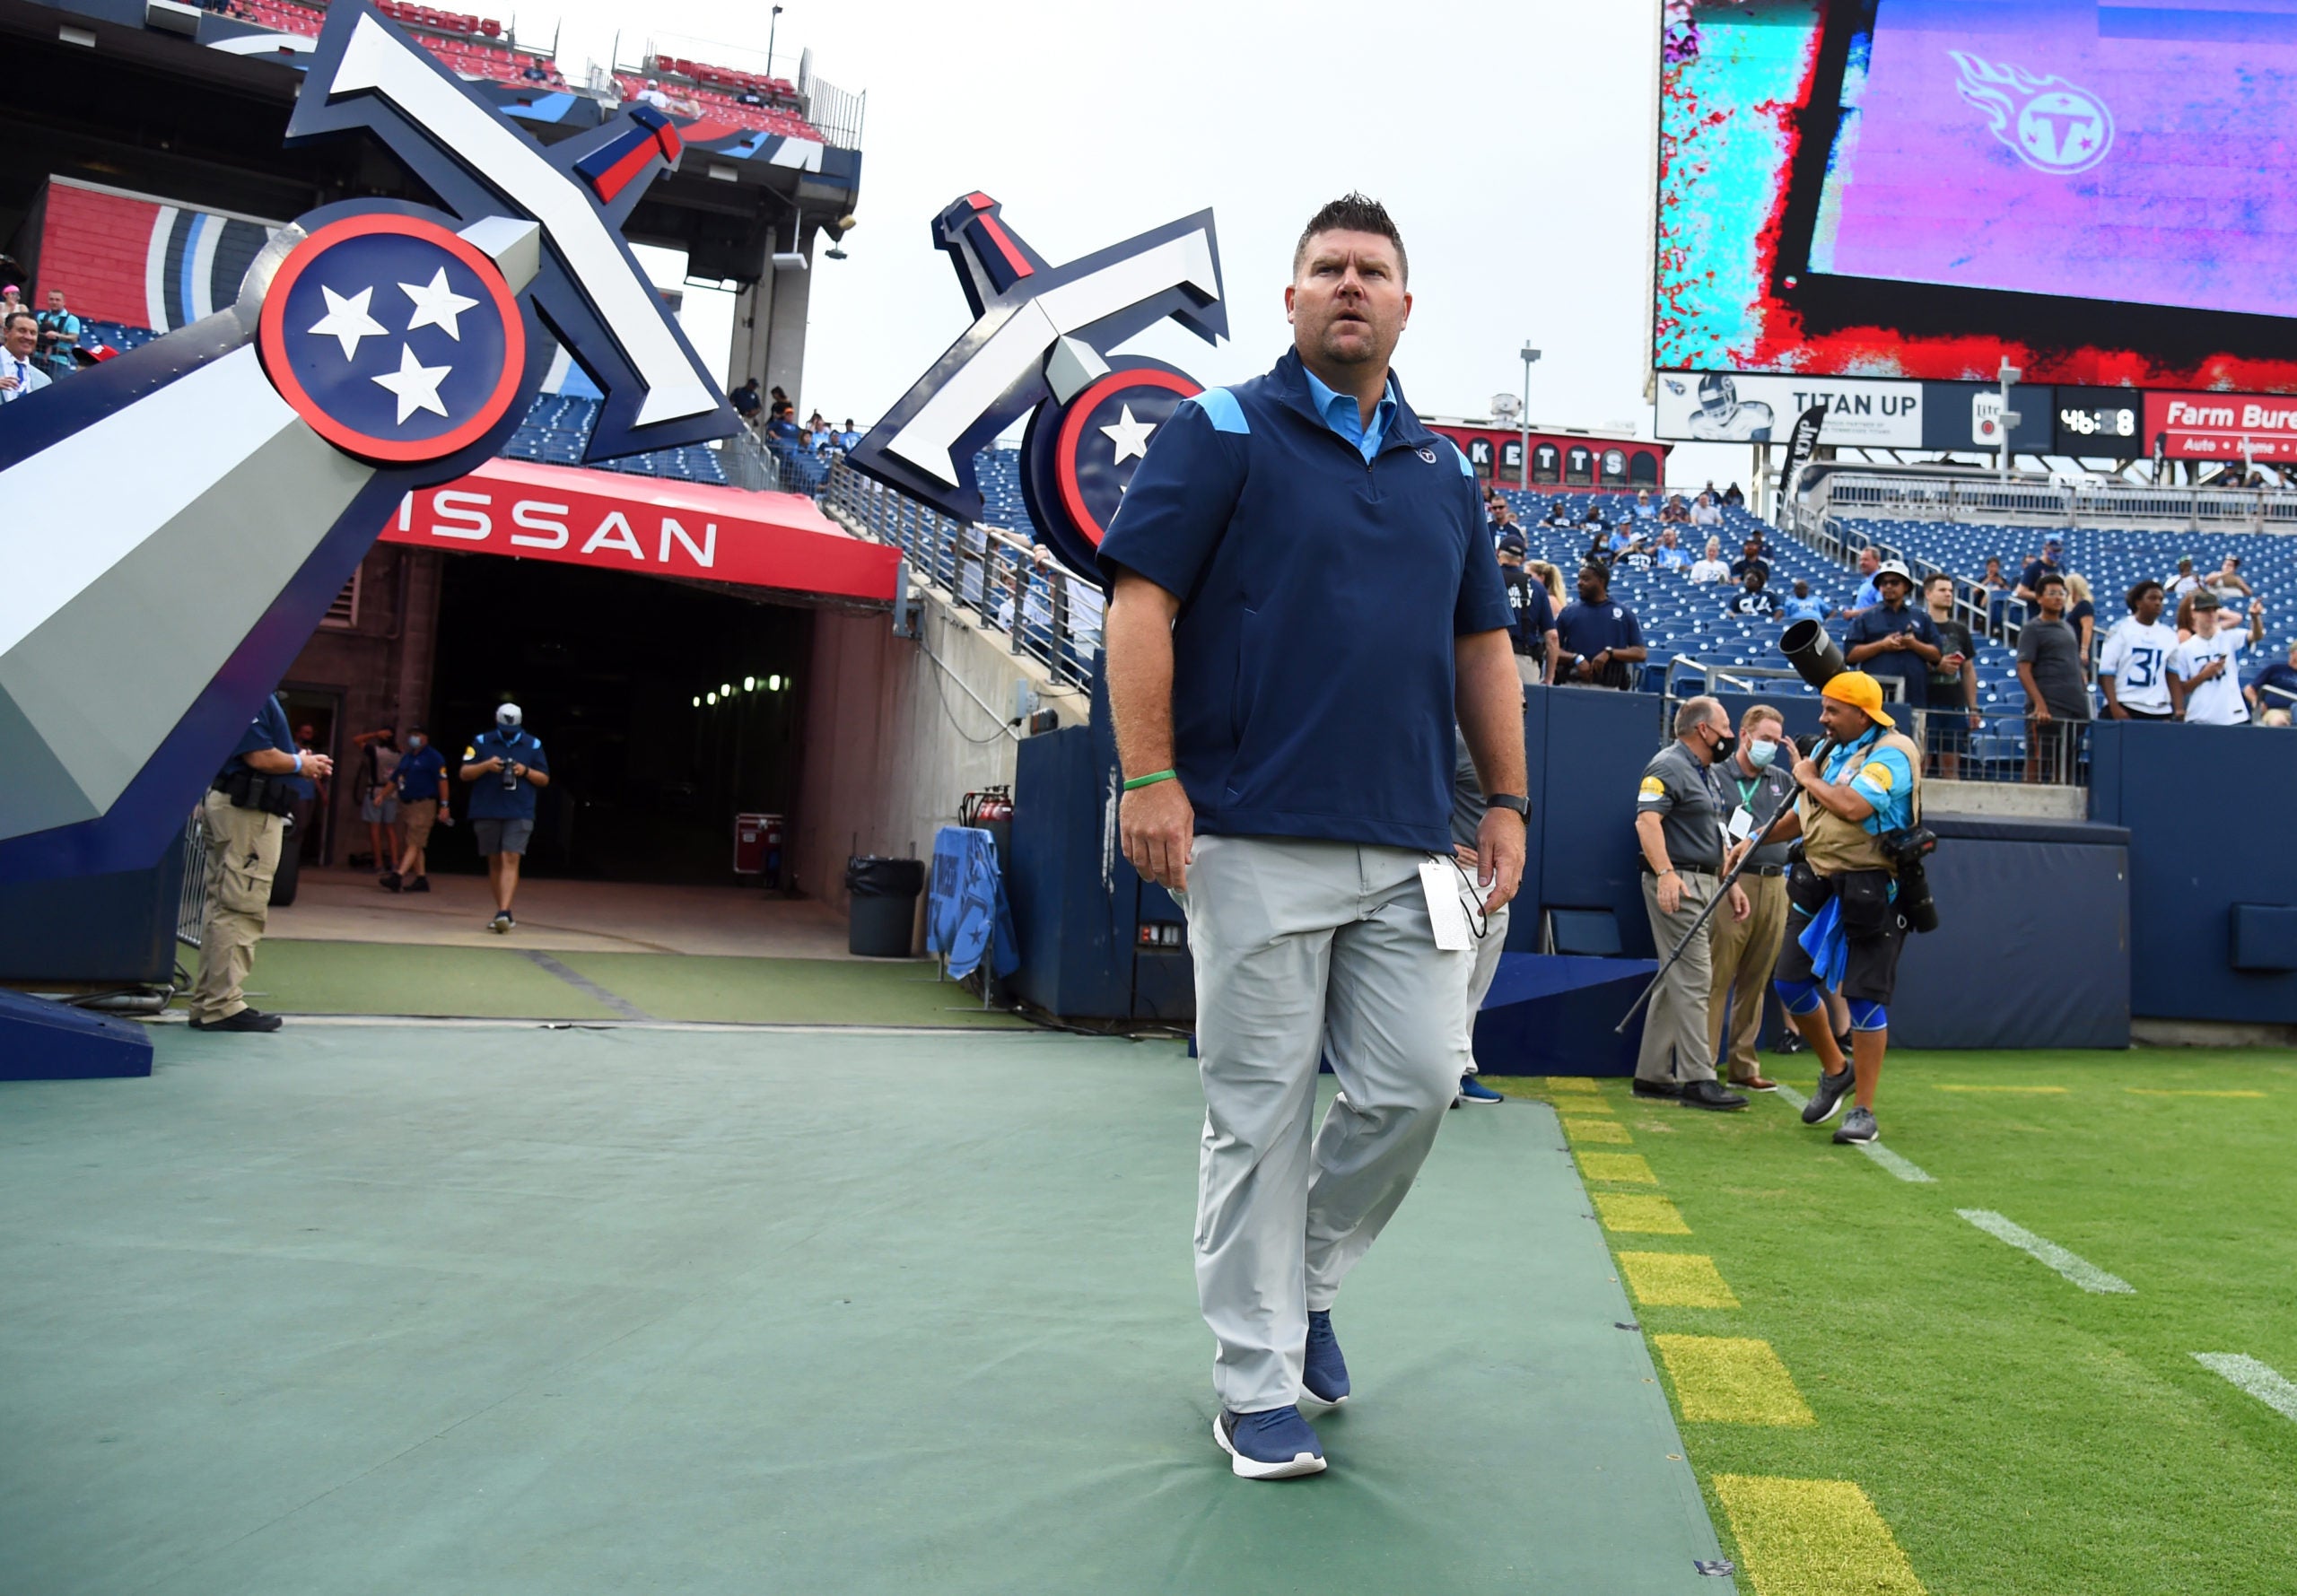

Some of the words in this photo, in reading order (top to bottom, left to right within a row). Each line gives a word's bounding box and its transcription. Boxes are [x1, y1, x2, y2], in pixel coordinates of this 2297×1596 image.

[1793, 392, 1871, 415] TITAN
[1881, 396, 1917, 417] UP
[2167, 401, 2234, 427] Farm
[2183, 437, 2216, 452] Auto
[2127, 648, 2163, 687] 31
